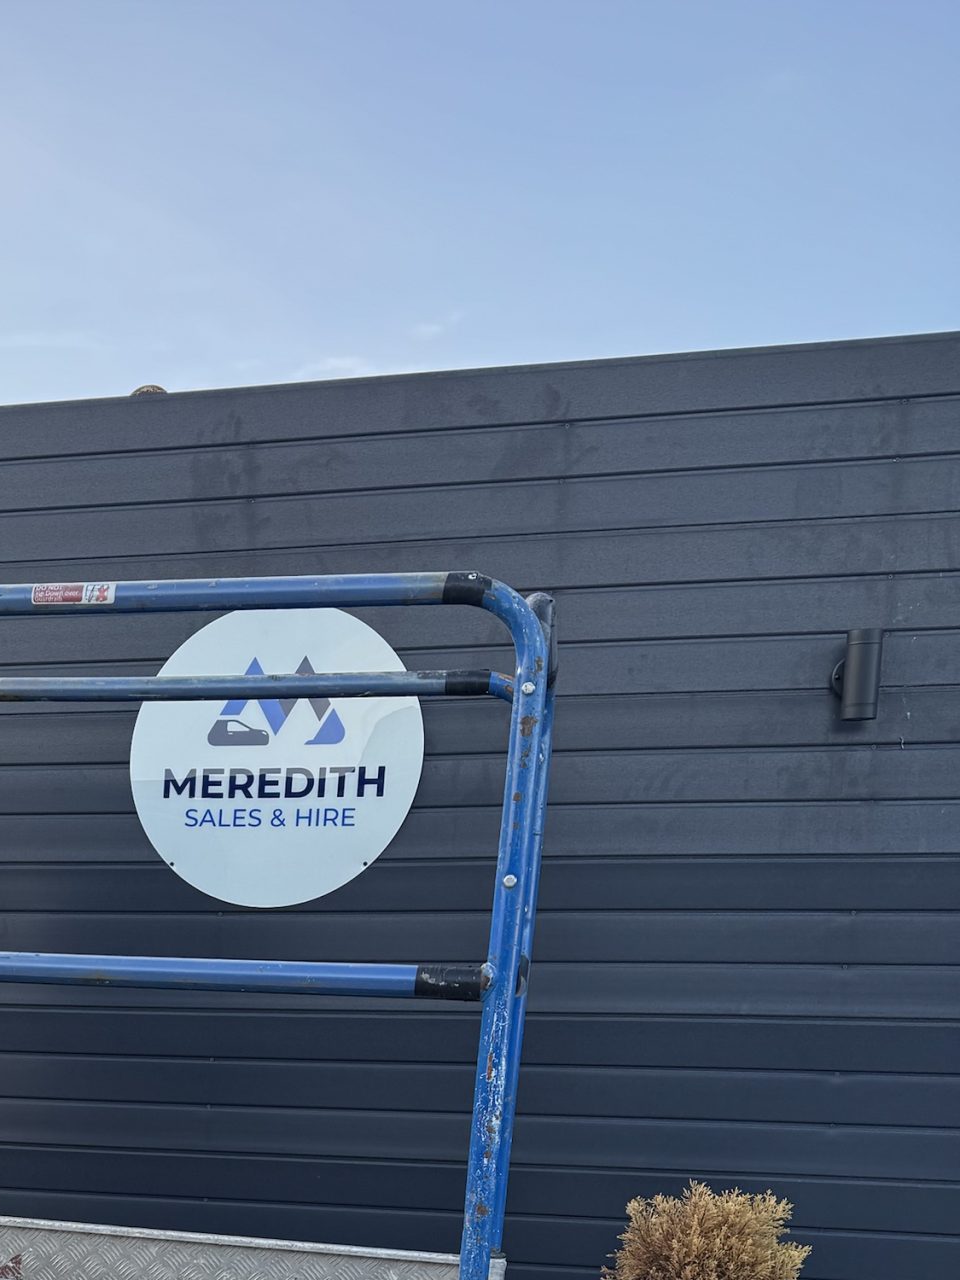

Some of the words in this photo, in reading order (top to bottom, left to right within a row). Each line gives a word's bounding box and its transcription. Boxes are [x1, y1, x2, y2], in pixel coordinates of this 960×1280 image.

[162, 766, 386, 799] MEREDITH
[184, 808, 262, 827] SALES
[270, 808, 286, 827] &
[295, 807, 356, 827] HIRE
